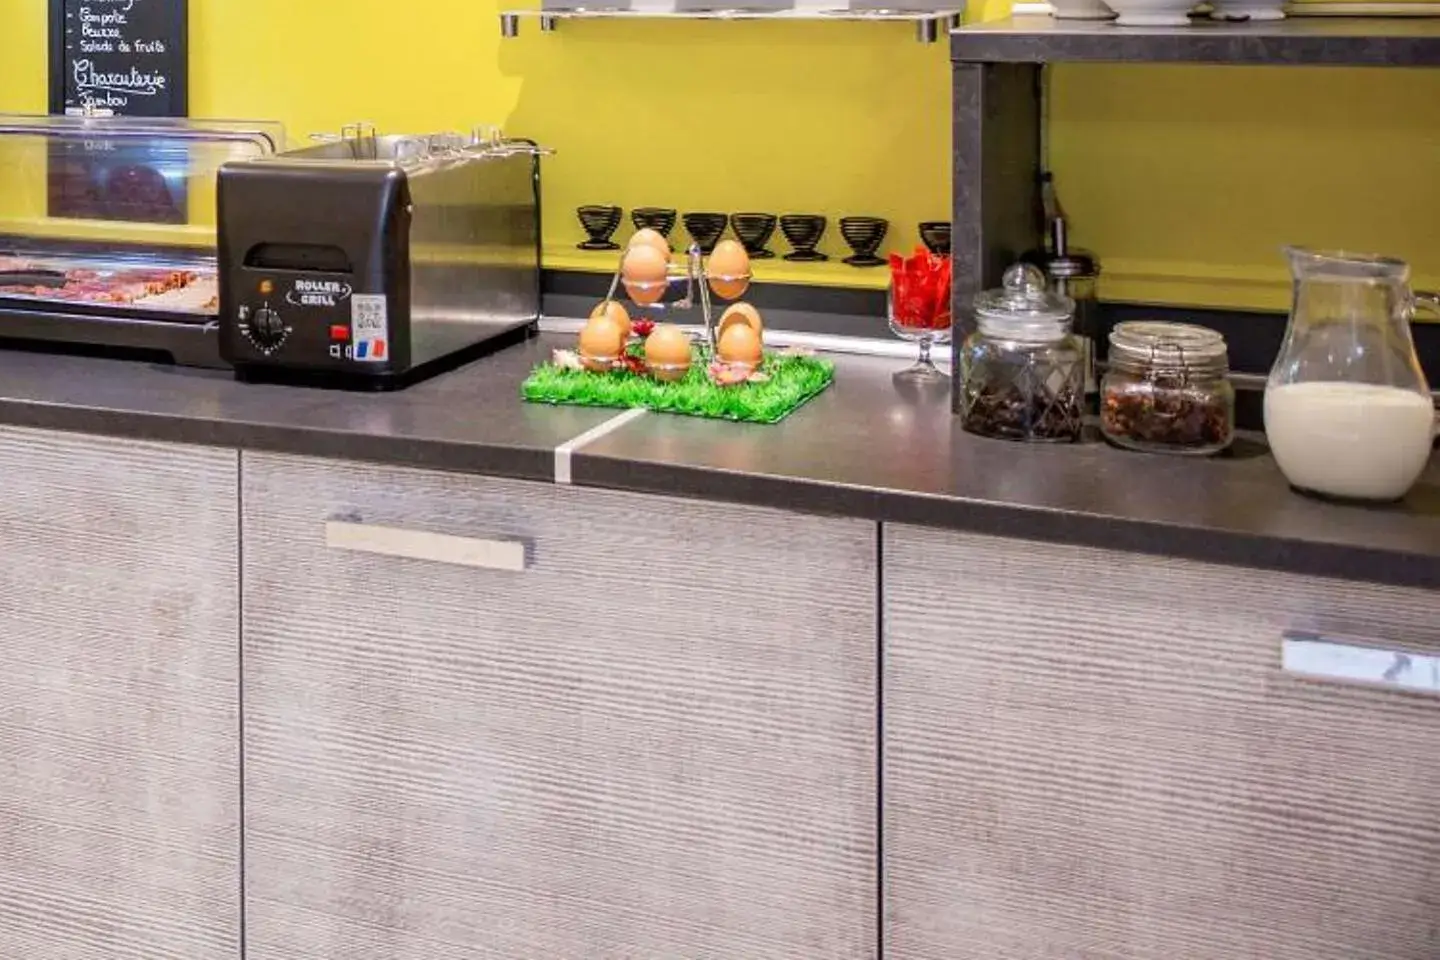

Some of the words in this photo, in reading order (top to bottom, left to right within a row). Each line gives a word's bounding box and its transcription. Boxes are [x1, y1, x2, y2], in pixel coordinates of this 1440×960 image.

[72, 58, 166, 88] Charcuterie
[295, 280, 341, 293] ROLLER
[301, 295, 335, 307] GRILL
